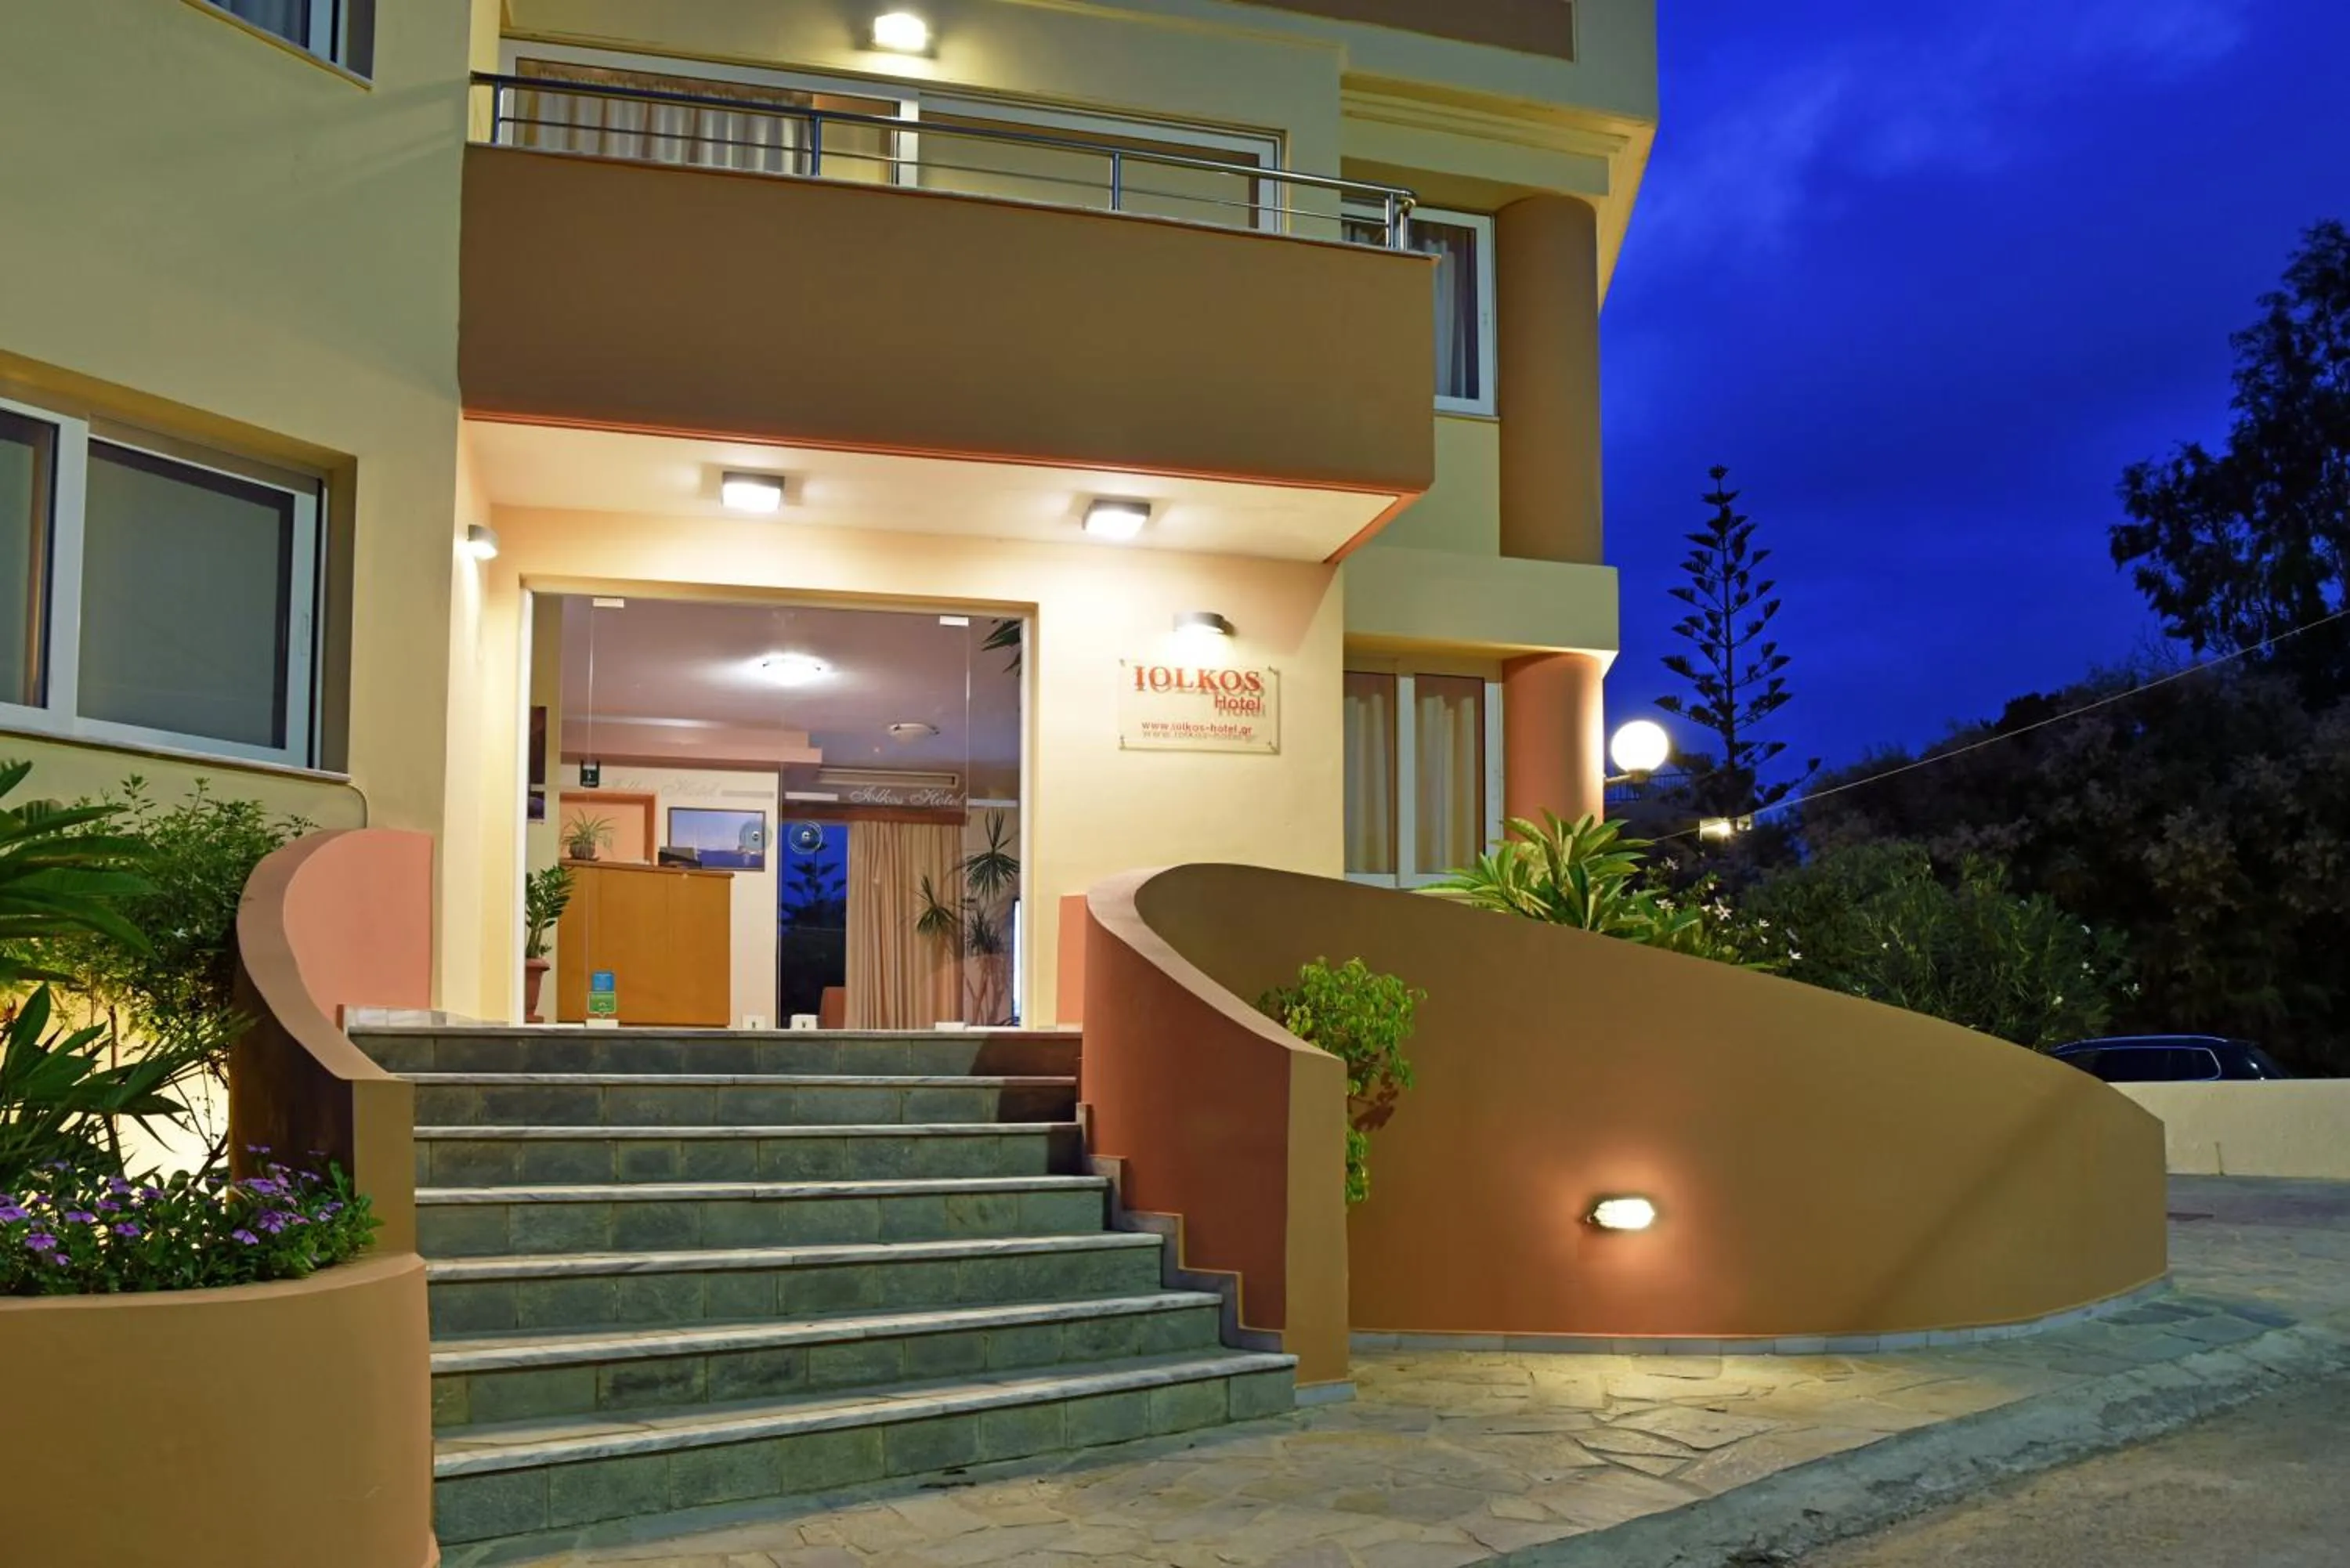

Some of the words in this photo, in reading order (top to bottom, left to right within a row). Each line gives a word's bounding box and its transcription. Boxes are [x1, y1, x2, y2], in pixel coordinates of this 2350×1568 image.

[1134, 666, 1261, 692] IOLKOS
[1215, 695, 1260, 711] Hotel
[1141, 721, 1253, 735] www.iolkos-hotel.gr
